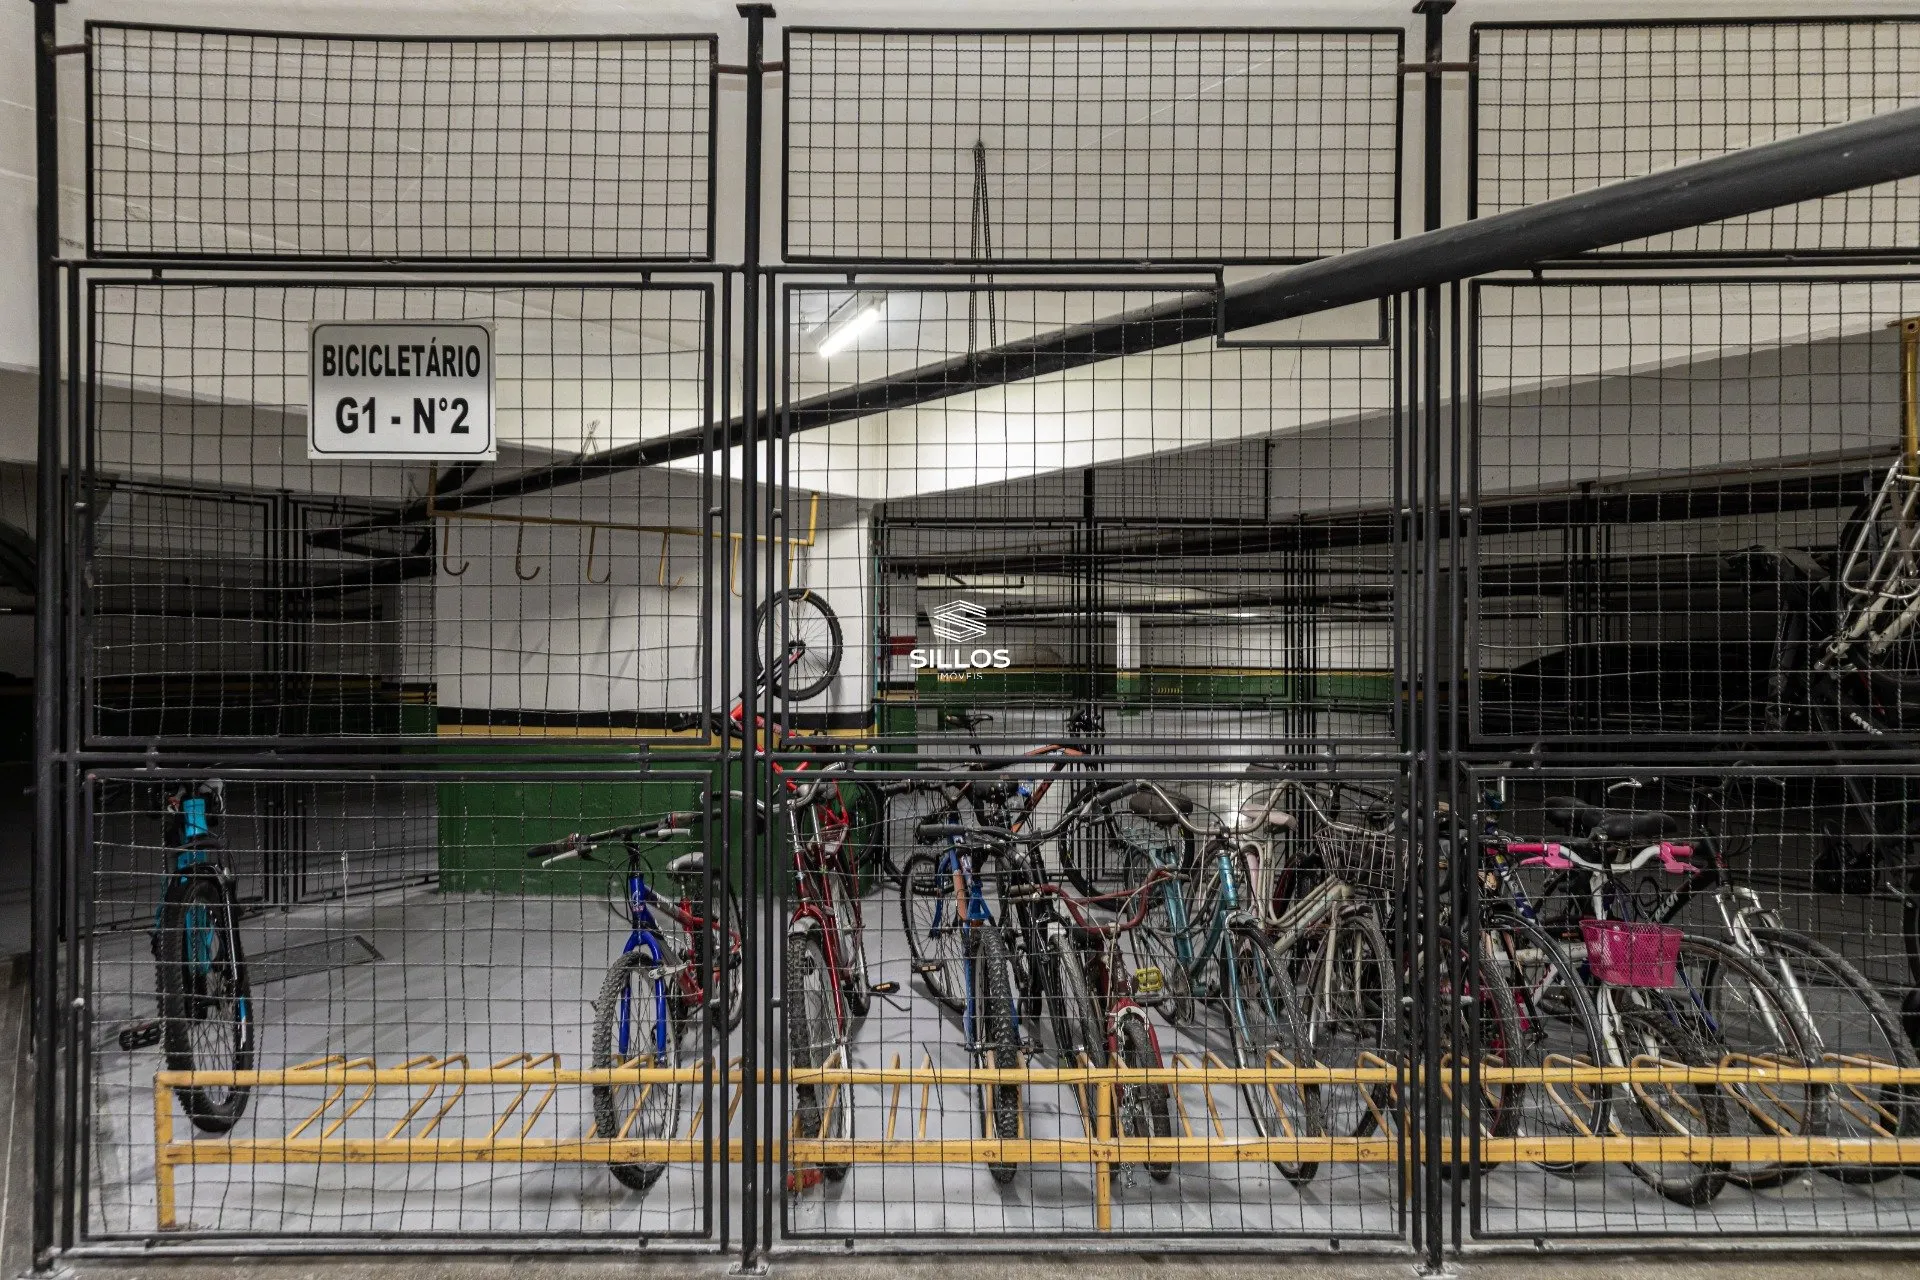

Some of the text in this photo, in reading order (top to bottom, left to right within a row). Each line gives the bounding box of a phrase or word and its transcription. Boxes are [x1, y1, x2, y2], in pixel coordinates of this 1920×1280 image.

[322, 336, 481, 378] BICICLETÁRIO
[335, 396, 376, 435] G1
[391, 416, 401, 425] -
